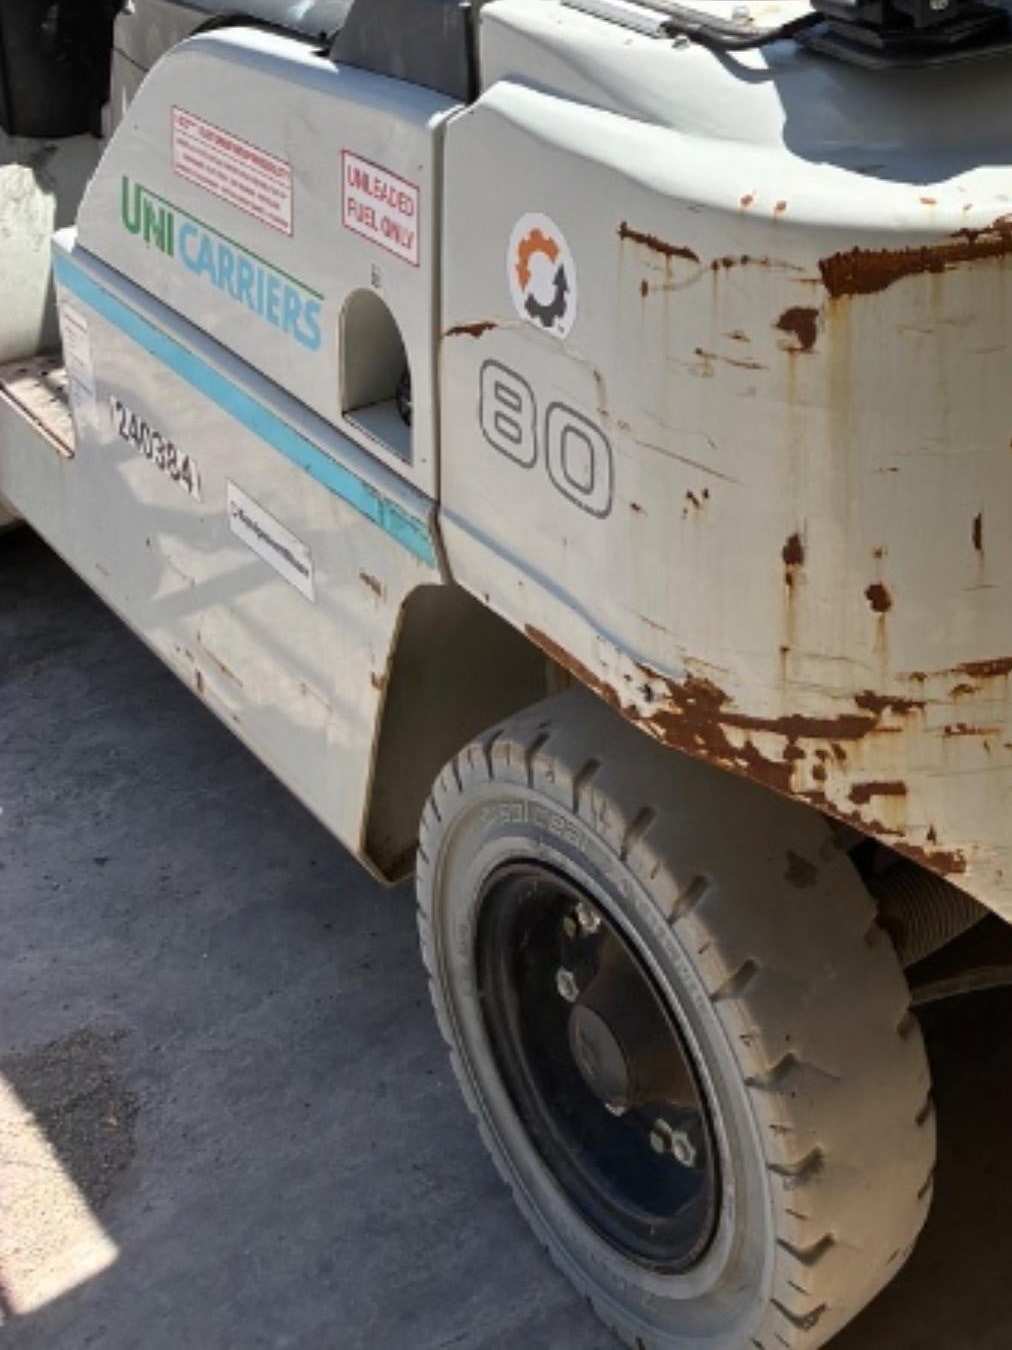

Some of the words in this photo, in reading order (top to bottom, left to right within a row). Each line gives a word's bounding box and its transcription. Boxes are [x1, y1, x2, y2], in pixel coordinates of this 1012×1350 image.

[346, 164, 414, 217] UNLEADED
[347, 196, 378, 232] FUEL
[381, 215, 414, 250] ONLY
[480, 358, 614, 519] 80
